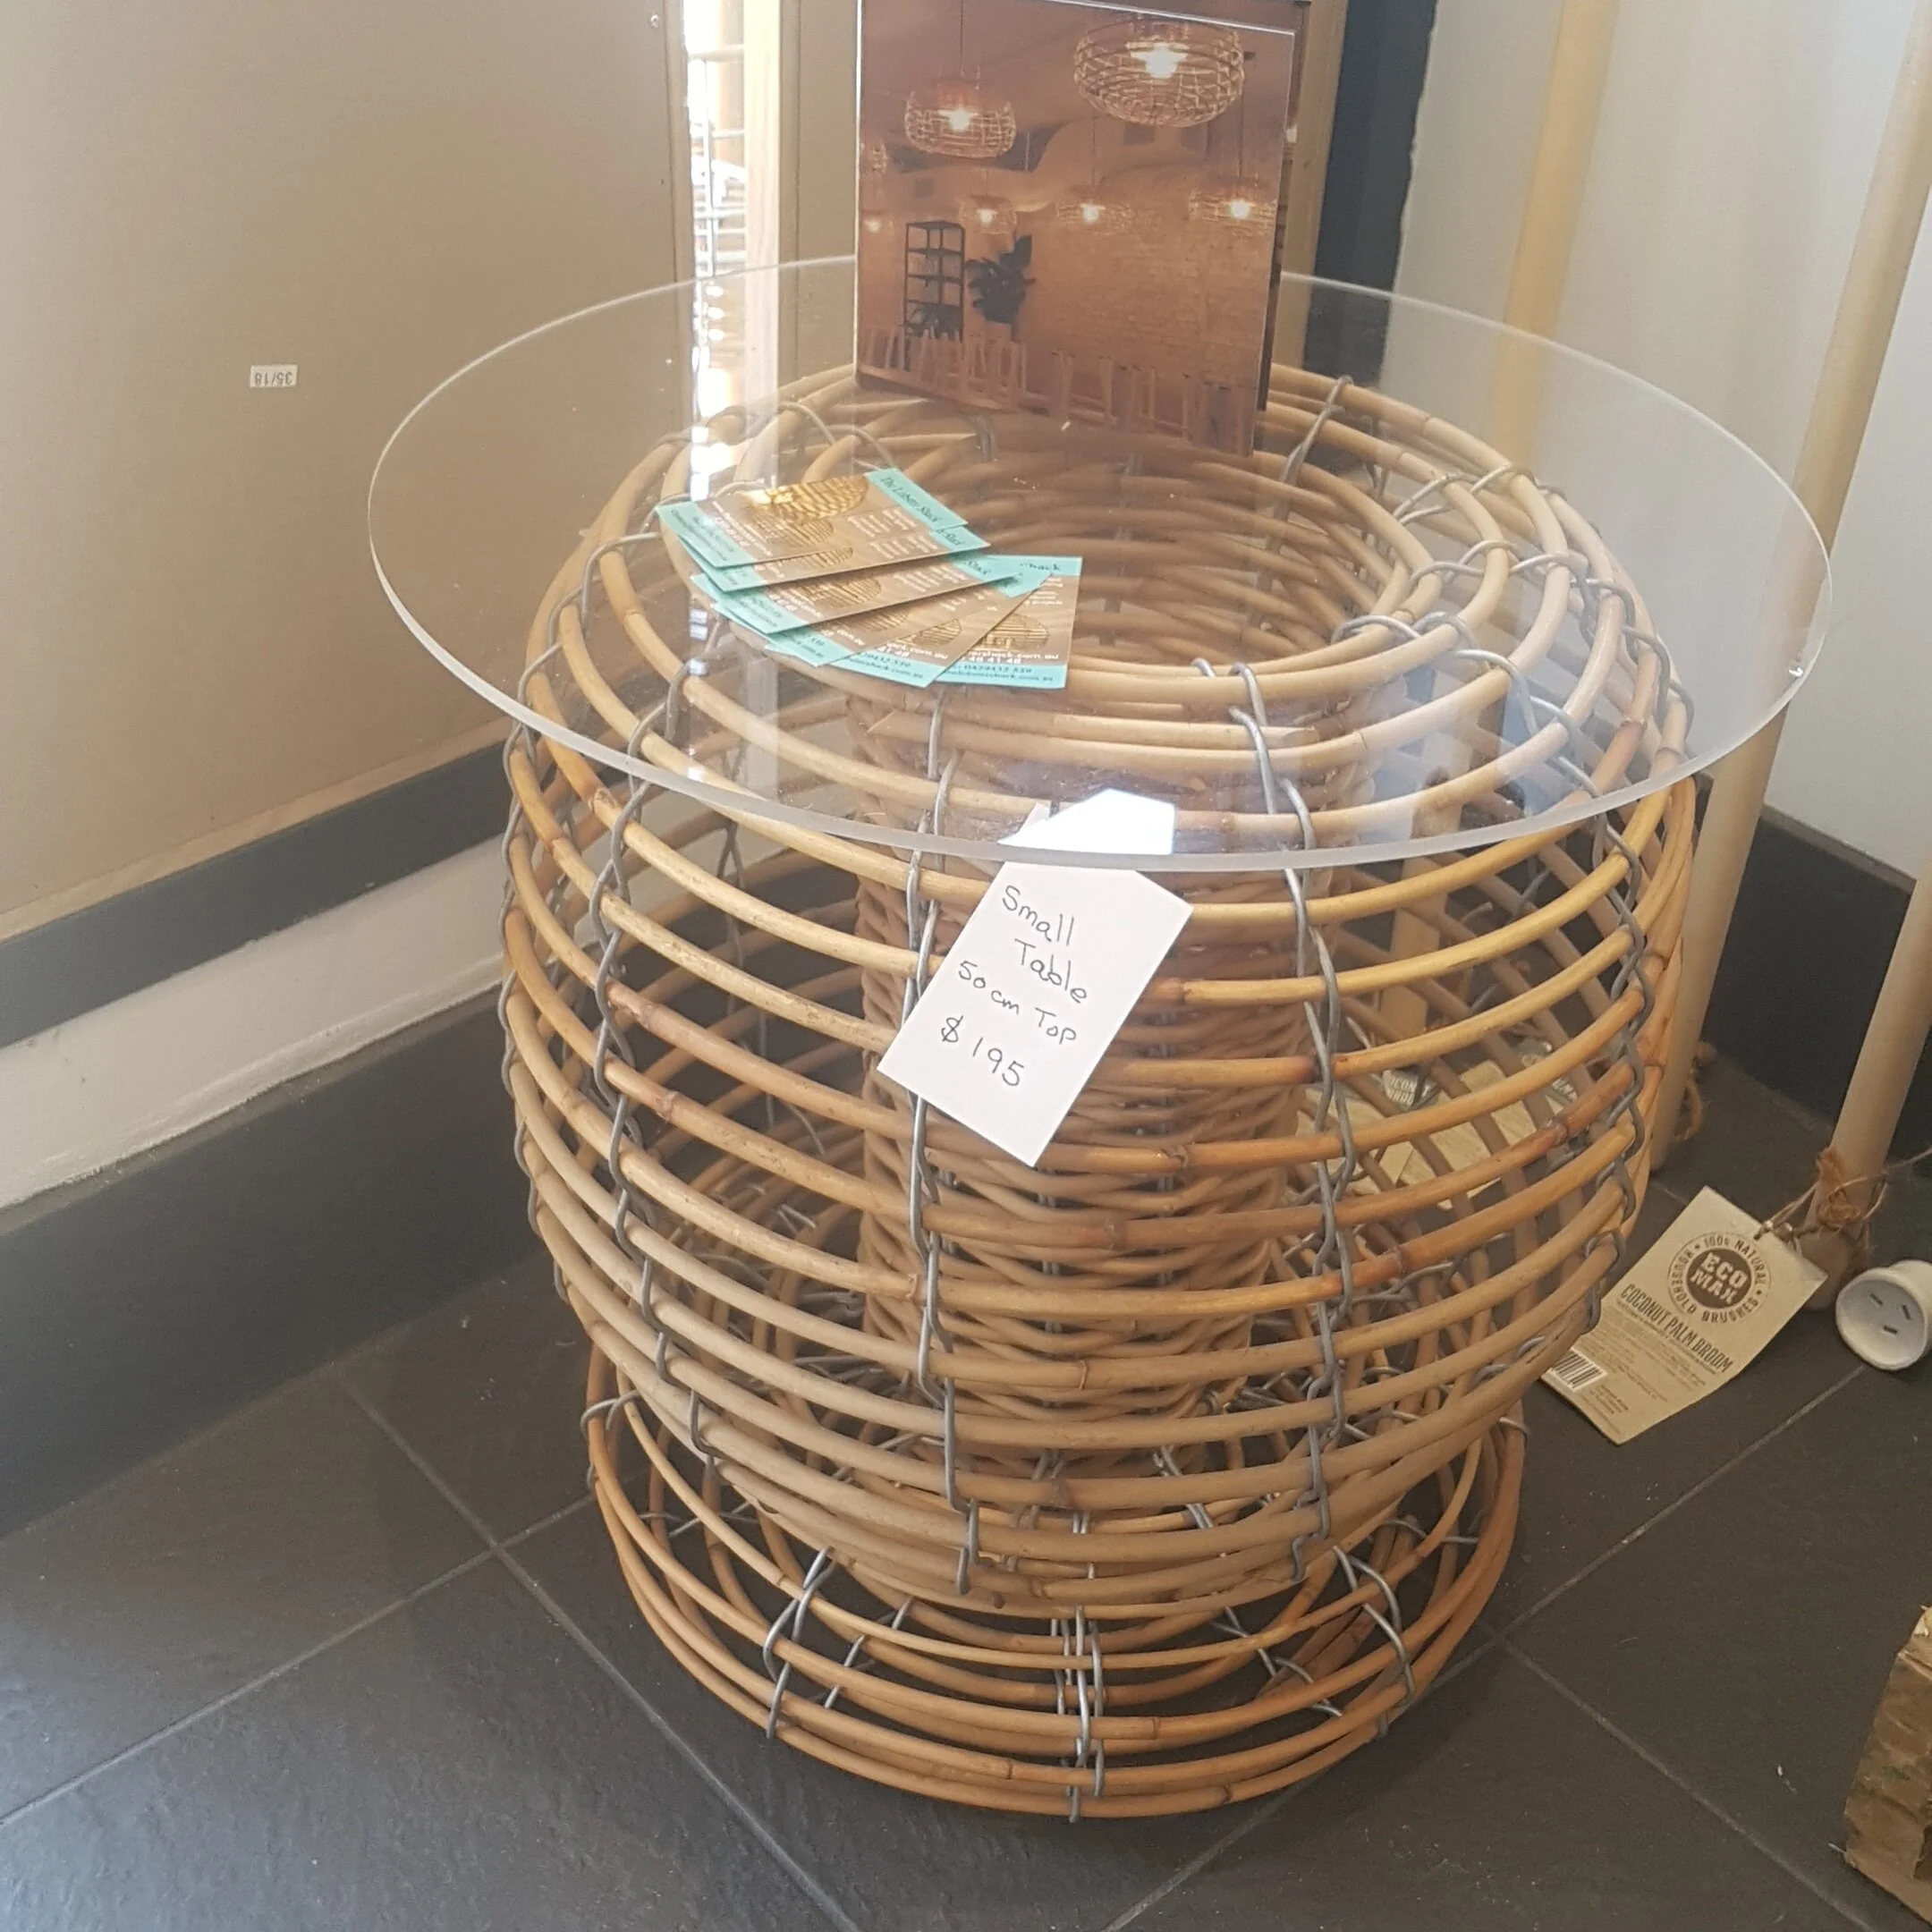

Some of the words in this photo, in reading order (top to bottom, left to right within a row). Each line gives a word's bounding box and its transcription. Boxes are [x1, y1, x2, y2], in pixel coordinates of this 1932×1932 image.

[1002, 885, 1075, 946] Small
[1014, 938, 1088, 1004] Table
[1671, 1249, 1697, 1314] HOUSEHOLD
[1701, 1297, 1758, 1323] BRUSHES
[1700, 1252, 1749, 1289] ECO
[1734, 1239, 1767, 1284] NATURAL
[1620, 1283, 1672, 1326] COCONUT
[1663, 1316, 1698, 1347] PALM
[1691, 1337, 1733, 1373] BROOM
